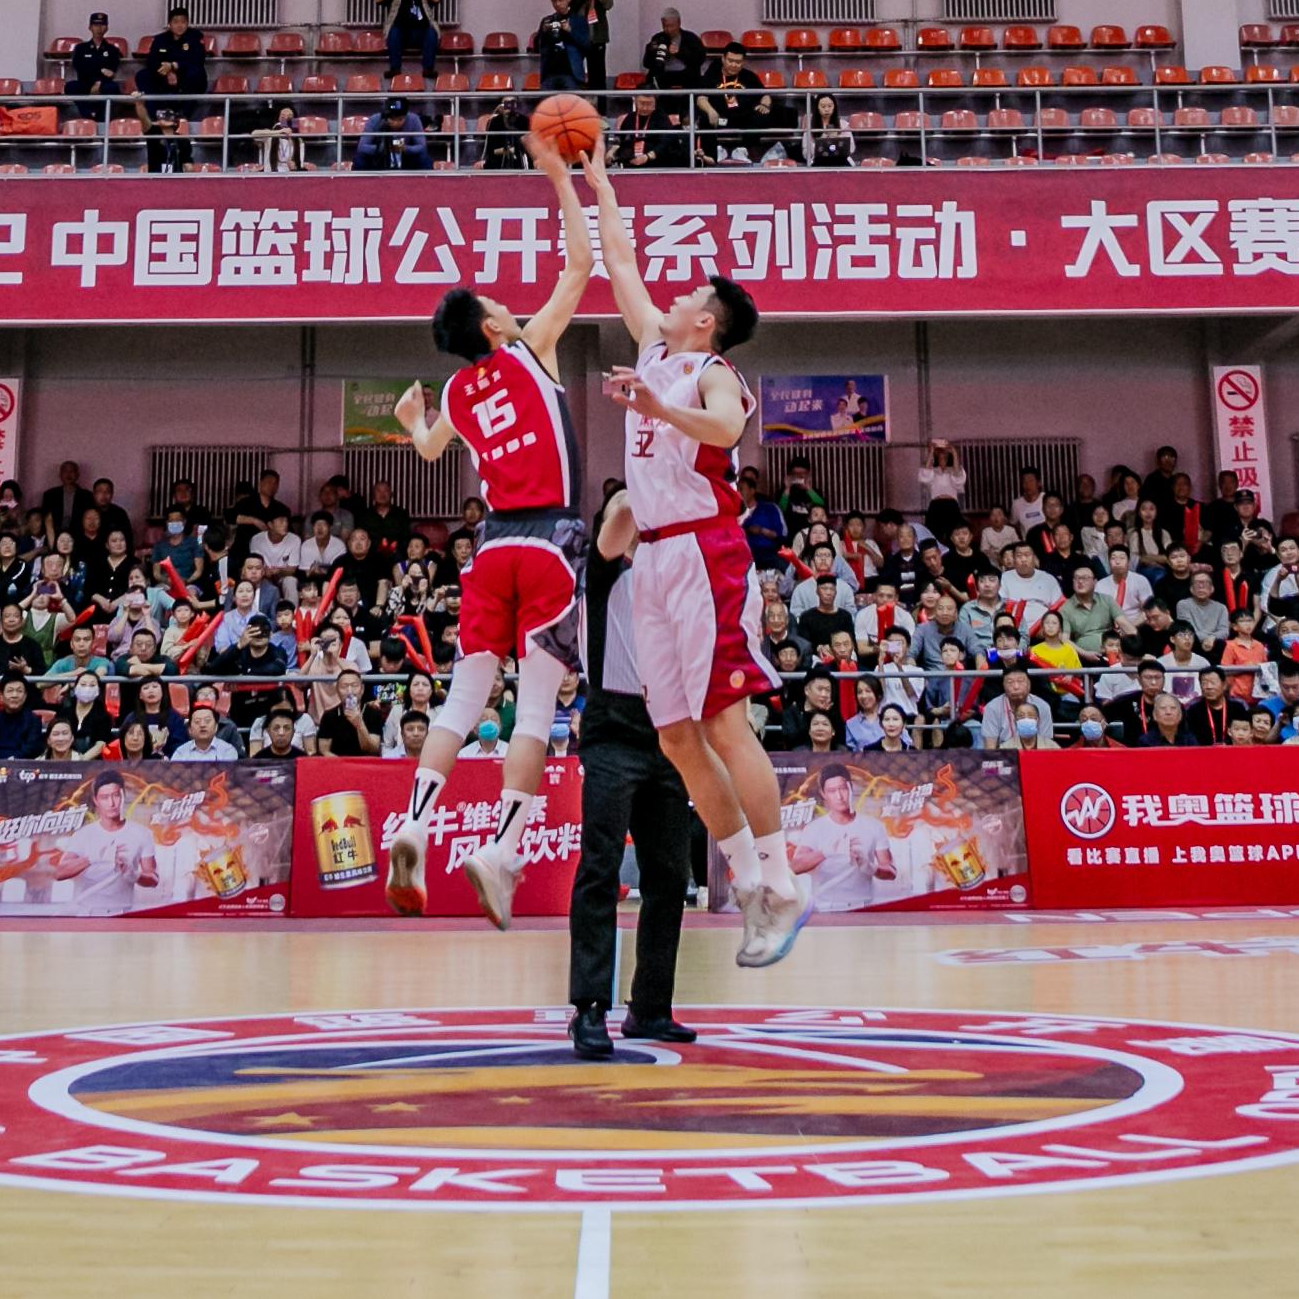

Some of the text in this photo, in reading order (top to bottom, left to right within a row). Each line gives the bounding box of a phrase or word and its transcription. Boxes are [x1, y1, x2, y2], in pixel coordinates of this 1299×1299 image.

[472, 388, 517, 439] 15
[333, 849, 358, 864] 红牛
[445, 822, 582, 874] 风饮料
[1067, 847, 1160, 865] 看比赛直播
[9, 1133, 1269, 1193] BASKETBALL
